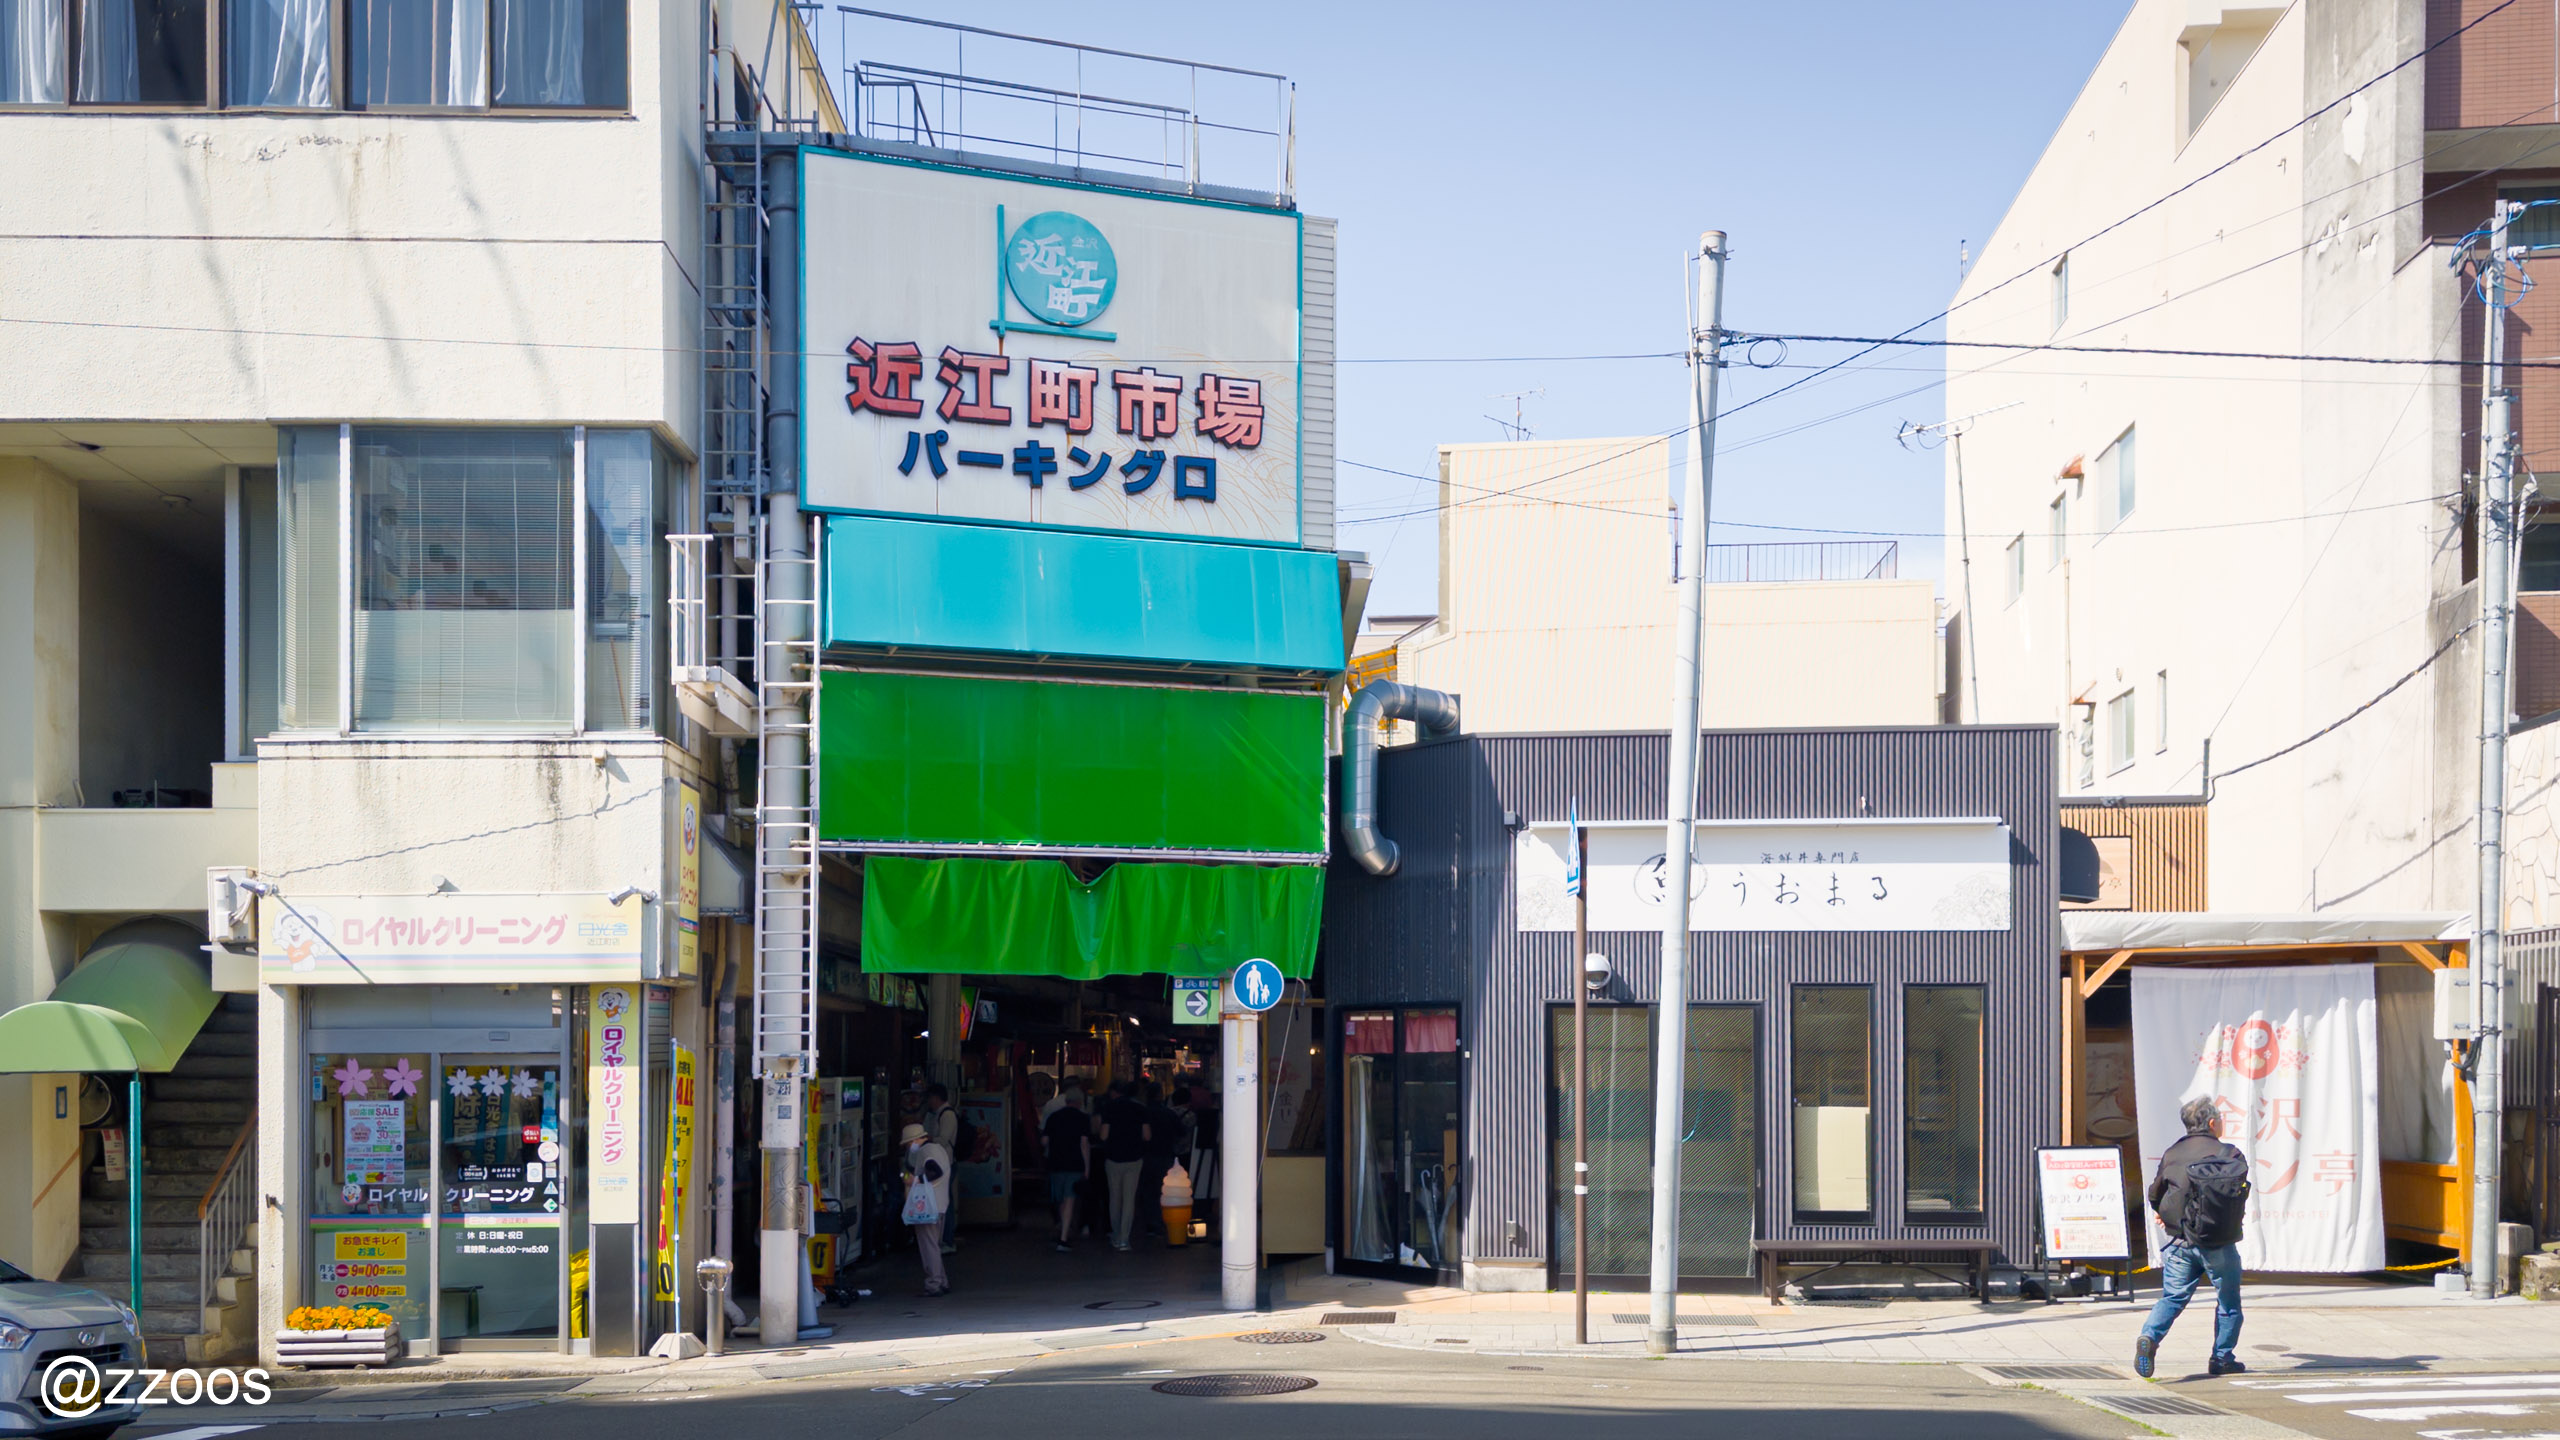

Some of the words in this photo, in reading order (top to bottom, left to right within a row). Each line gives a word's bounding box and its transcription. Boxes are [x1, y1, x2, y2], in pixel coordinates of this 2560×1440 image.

[1016, 233, 1108, 319] 近江町
[845, 336, 1266, 450] 近江町市場
[898, 429, 1218, 503] パーキング口
[1732, 871, 1888, 907] うおまる
[342, 914, 568, 946] ロイヤルクリーニング
[376, 1108, 399, 1116] SALE
[602, 1026, 625, 1164] ロイヤルクリーニング
[2213, 1094, 2303, 1142] 金沢
[369, 1188, 428, 1202] ロイヤル
[445, 1187, 535, 1203] クリーニング
[343, 1236, 400, 1246] お急ぎキレイ
[357, 1247, 386, 1257] お渡し
